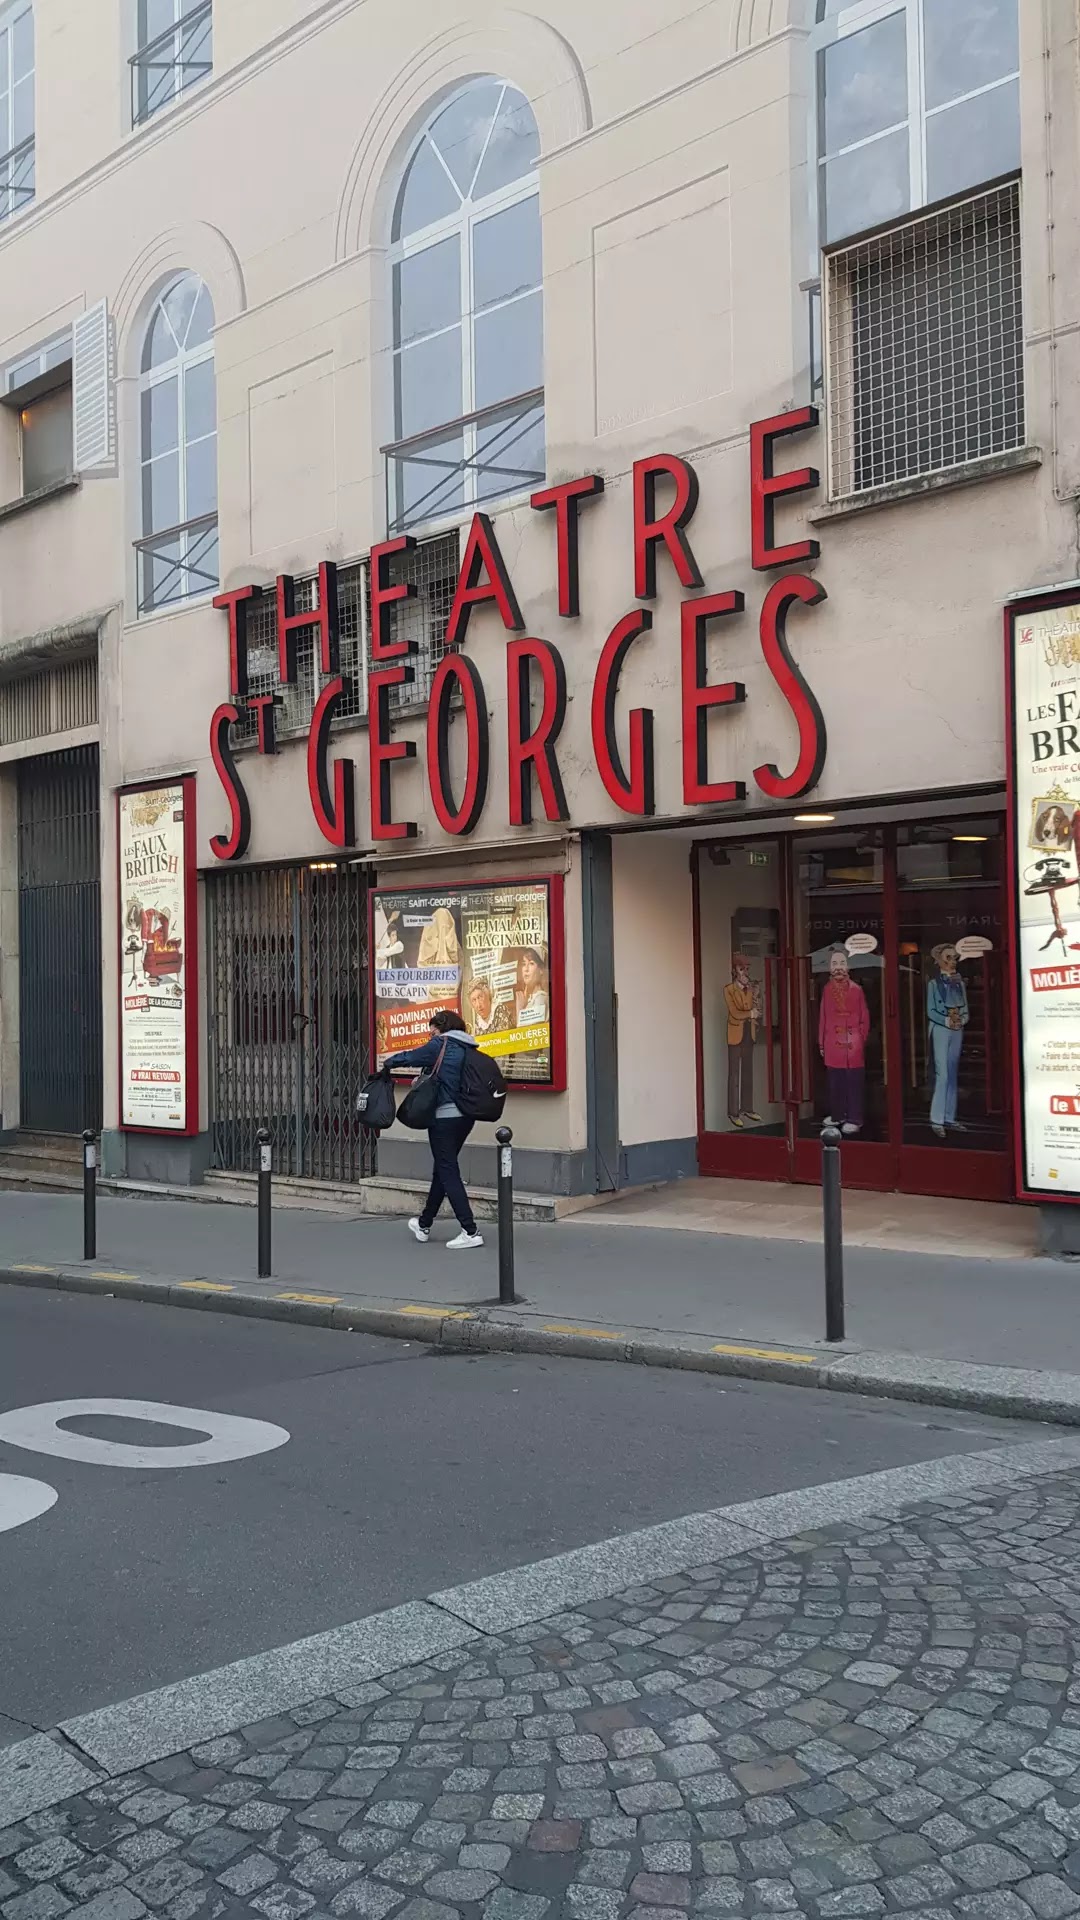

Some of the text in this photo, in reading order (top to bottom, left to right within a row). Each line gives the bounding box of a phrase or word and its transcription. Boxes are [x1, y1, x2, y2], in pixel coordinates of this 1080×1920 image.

[213, 406, 820, 697] THEATRE
[308, 574, 828, 848] GEORGES
[1027, 690, 1080, 724] LES F
[124, 834, 167, 859] LES FAUX
[125, 853, 178, 880] BRITISH
[469, 917, 539, 933] LE MALADE
[467, 932, 541, 948] IMAGINAIRE
[378, 969, 457, 981] LES FOURBERIES
[381, 987, 392, 997] DE
[394, 986, 428, 997] SCAPIN
[125, 997, 148, 1008] MOLIÈRE
[509, 1028, 548, 1042] MOLIÈRES
[152, 1071, 175, 1081] RETOUR
[1052, 1097, 1069, 1112] le
